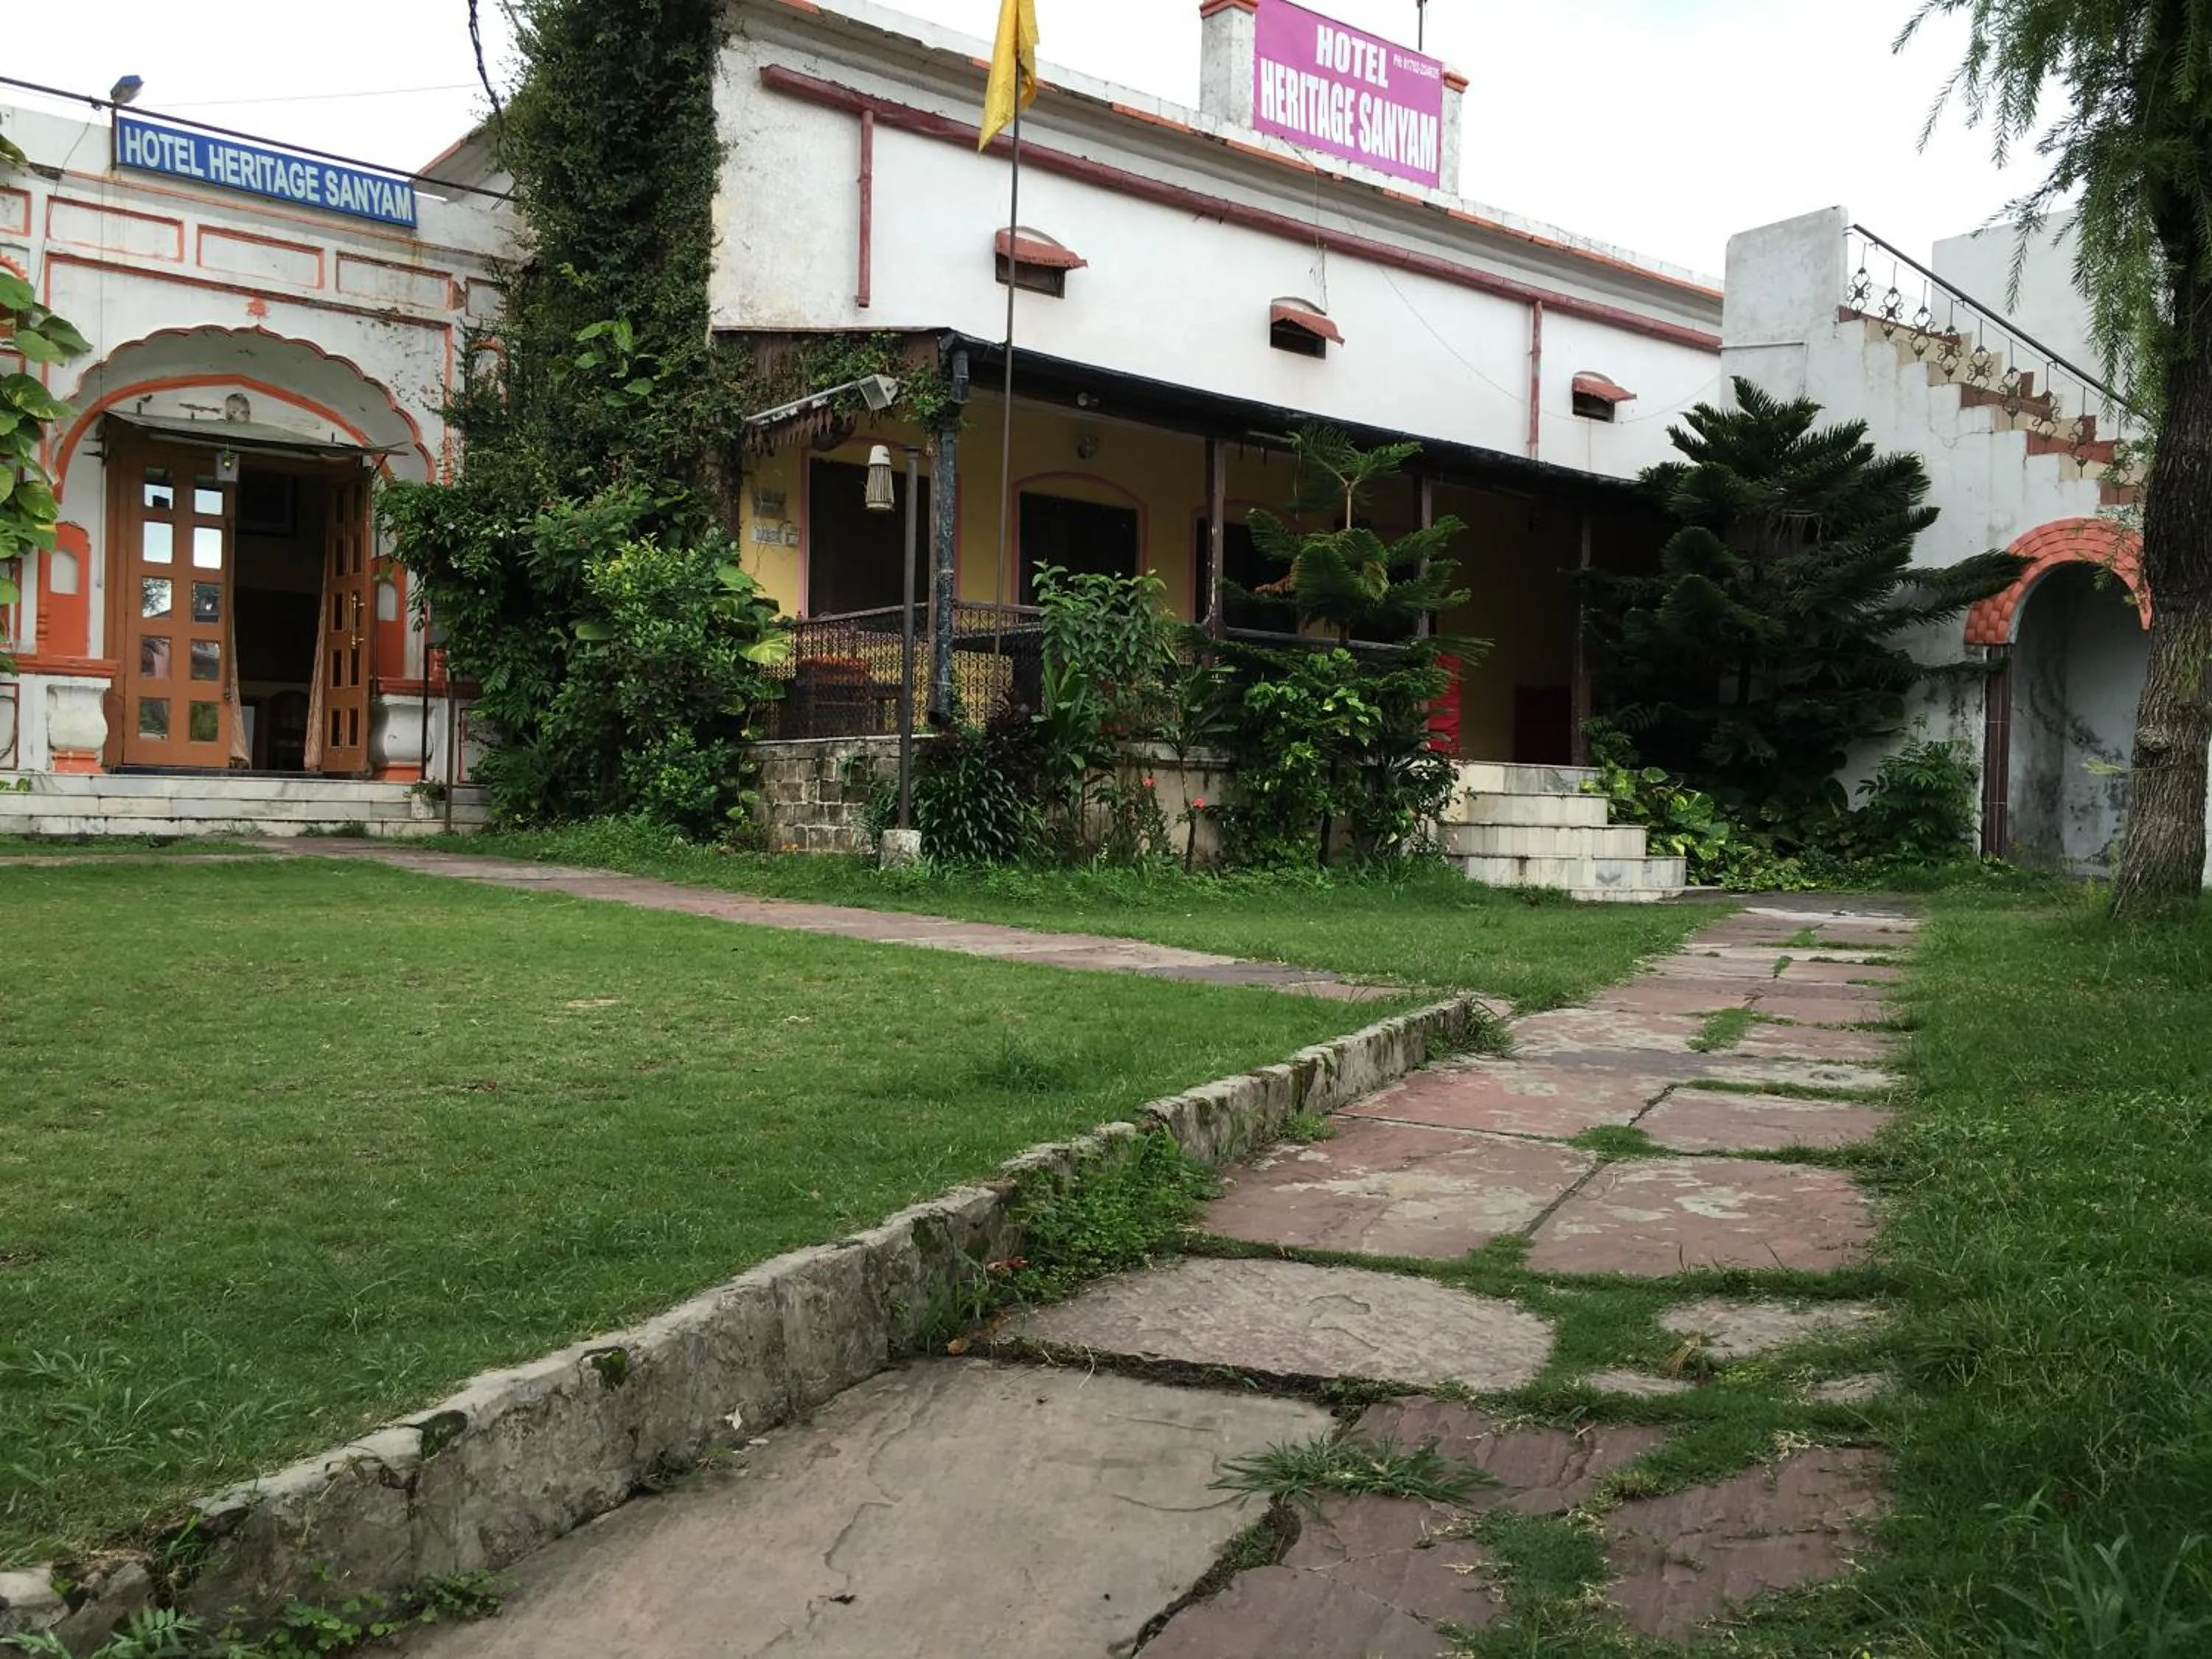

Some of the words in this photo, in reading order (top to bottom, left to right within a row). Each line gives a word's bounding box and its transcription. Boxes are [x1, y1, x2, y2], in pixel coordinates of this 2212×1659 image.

[1316, 24, 1388, 88] HOTEL
[1260, 57, 1355, 147] HERITAGE
[1359, 91, 1437, 174] SANYAM
[125, 125, 204, 177] HOTEL
[209, 144, 320, 201] HERITAGE
[325, 170, 413, 220] SANYAM
